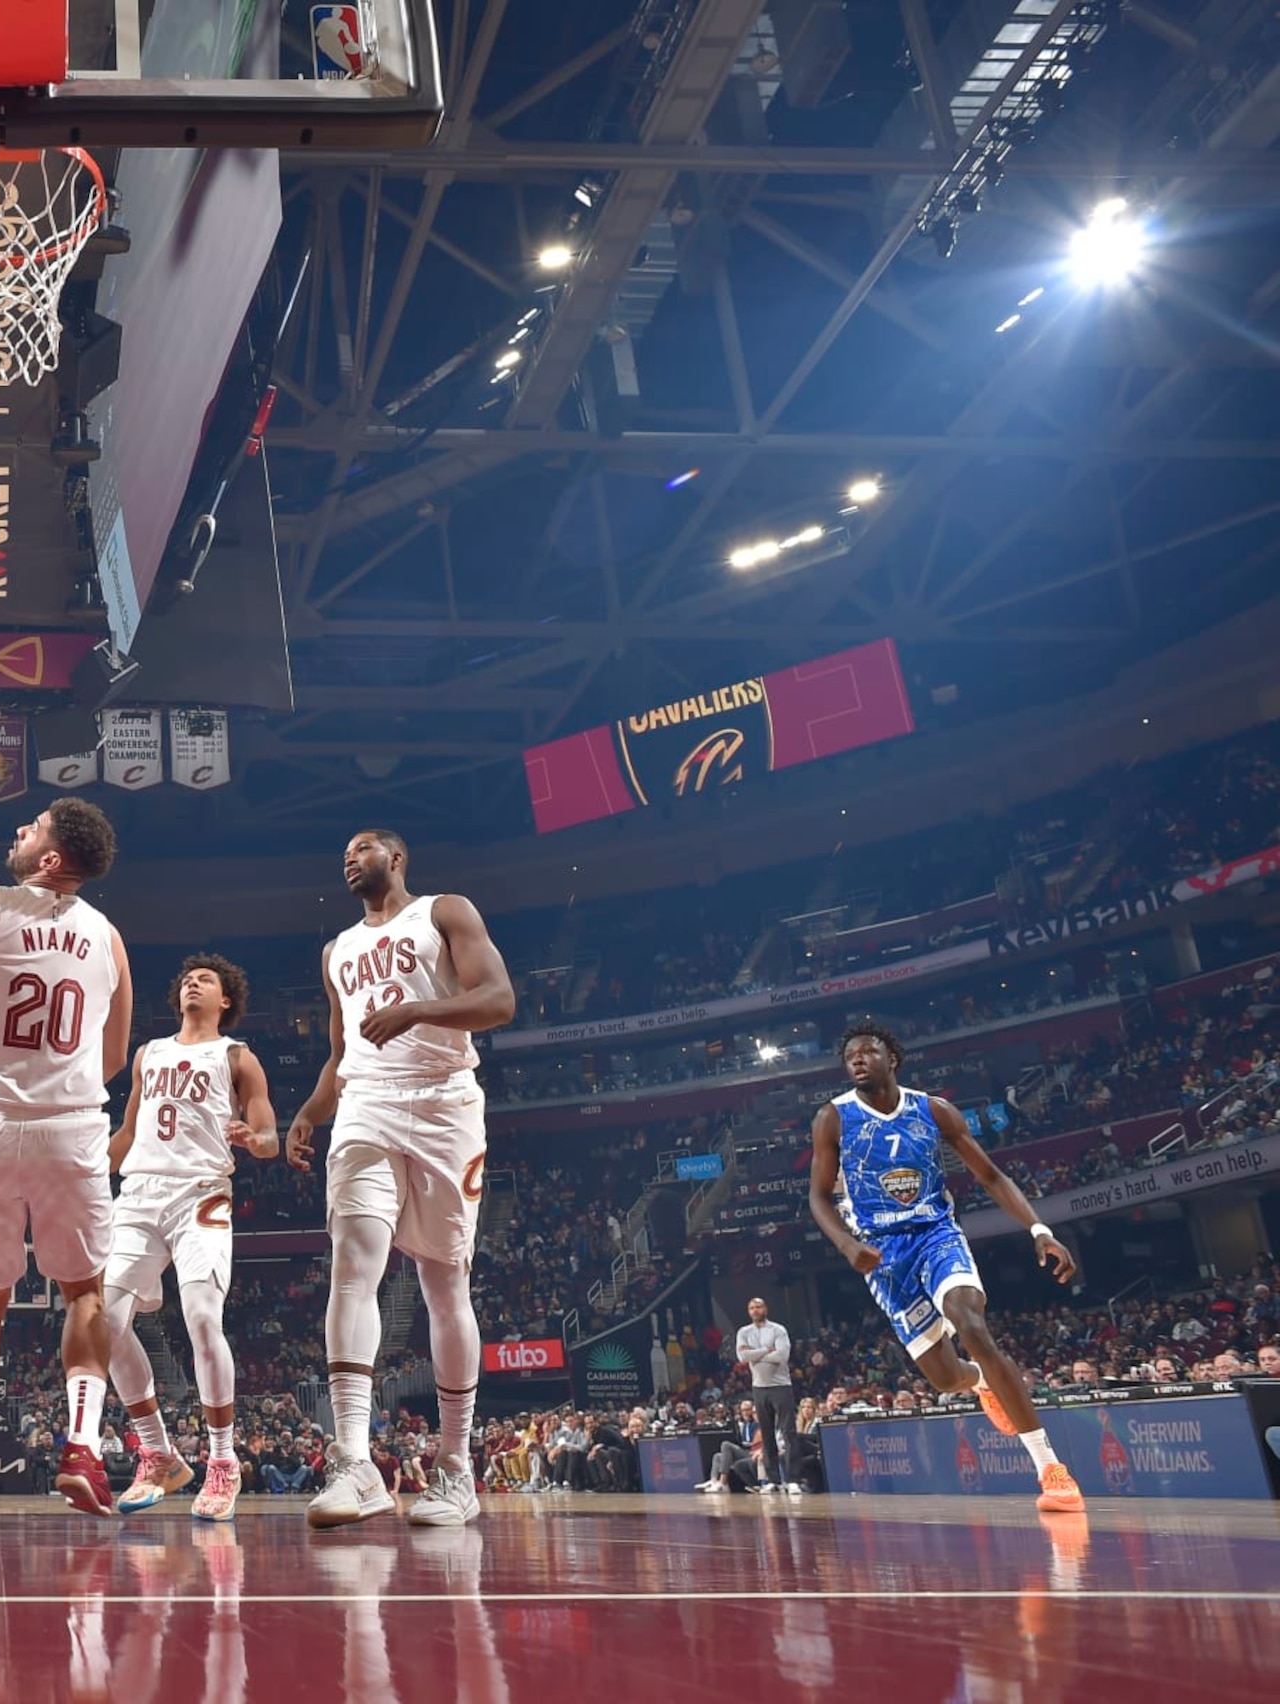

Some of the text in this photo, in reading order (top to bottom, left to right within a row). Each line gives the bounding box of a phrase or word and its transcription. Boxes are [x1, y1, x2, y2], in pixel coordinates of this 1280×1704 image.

[106, 739, 159, 750] CONFERENCE
[113, 728, 151, 738] EASTERN
[108, 750, 158, 761] CHAMPIONS
[21, 927, 92, 961] NIANG
[338, 937, 417, 997] CAVS
[3, 972, 85, 1056] 20
[546, 1007, 709, 1041] money's hard. we can help.
[278, 1055, 299, 1065] TOL
[143, 1062, 211, 1104] CAVS
[157, 1104, 177, 1141] 9
[884, 1133, 902, 1158] 7
[1069, 1148, 1269, 1213] money's hard. we can help.
[754, 1251, 773, 1268] 23
[892, 1311, 910, 1335] 7
[497, 1343, 548, 1368] fubo
[586, 1371, 639, 1382] CASAMIGOS
[1127, 1418, 1202, 1445] SHERWIN
[864, 1435, 908, 1454] SHERWIN
[865, 1456, 913, 1476] WILLIAMS
[1129, 1448, 1211, 1473] WILLIAMS
